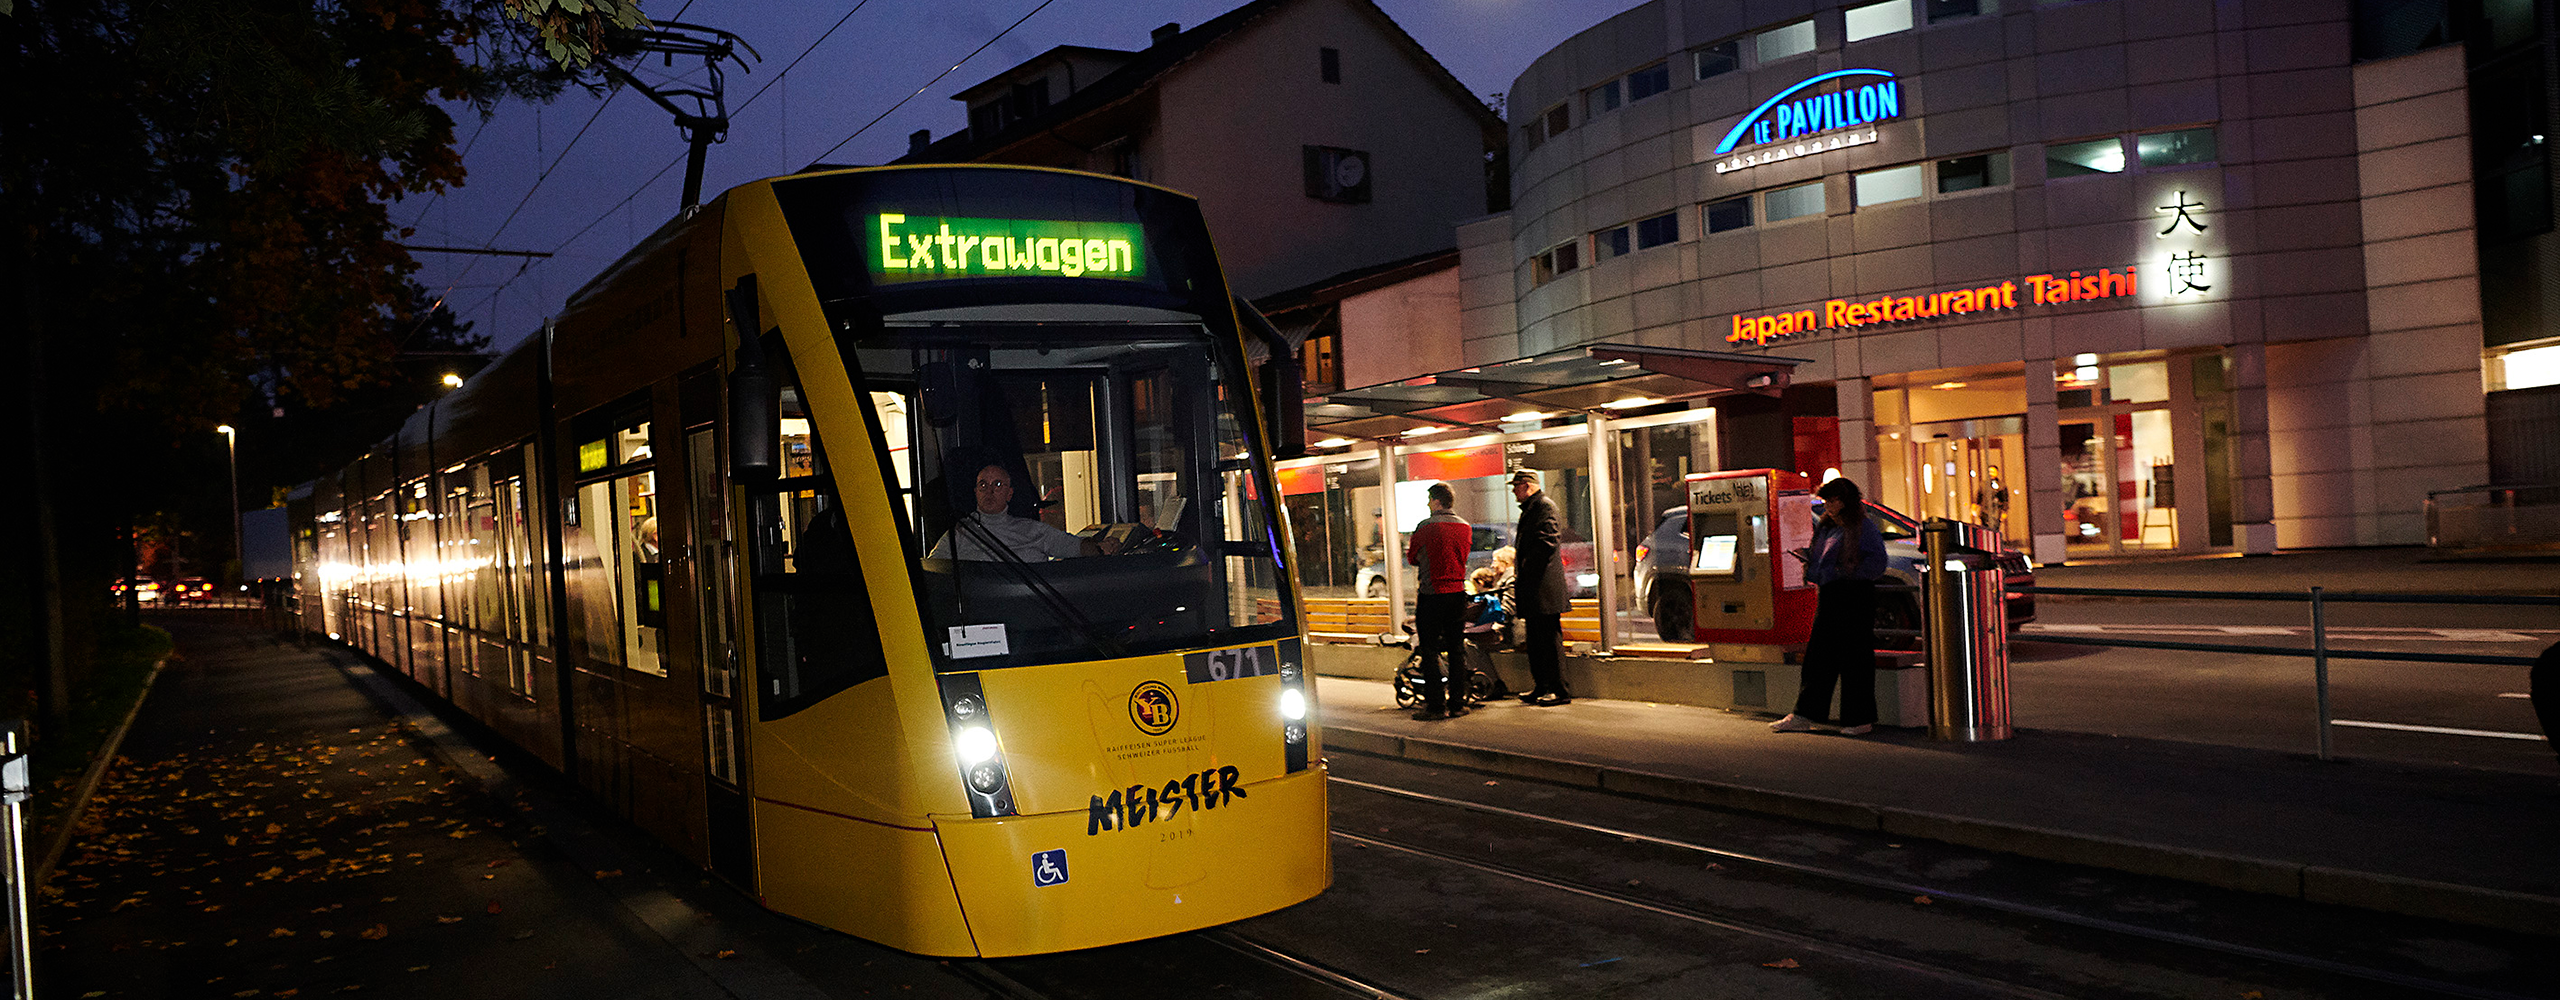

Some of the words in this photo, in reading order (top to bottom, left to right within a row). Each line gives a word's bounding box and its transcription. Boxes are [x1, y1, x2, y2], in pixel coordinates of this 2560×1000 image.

[1754, 120, 1773, 145] LE
[1776, 80, 1899, 140] PAVILLON
[880, 213, 1133, 277] Extrawagen
[2155, 190, 2211, 297] 大使
[1726, 309, 1816, 345] Japan
[1825, 280, 2018, 328] Restaurant
[2025, 266, 2137, 304] Taishi
[1693, 490, 1733, 505] Tickets
[1207, 646, 1261, 681] 671
[1106, 742, 1151, 753] RAIFFEISEN
[1154, 739, 1177, 747] SUPER
[1180, 735, 1206, 744] LEAGUE
[1117, 749, 1160, 760] SCHWEIZER
[1163, 745, 1200, 755] FUSSBALL
[1087, 765, 1247, 836] MEISTER
[1160, 829, 1194, 843] 2019
